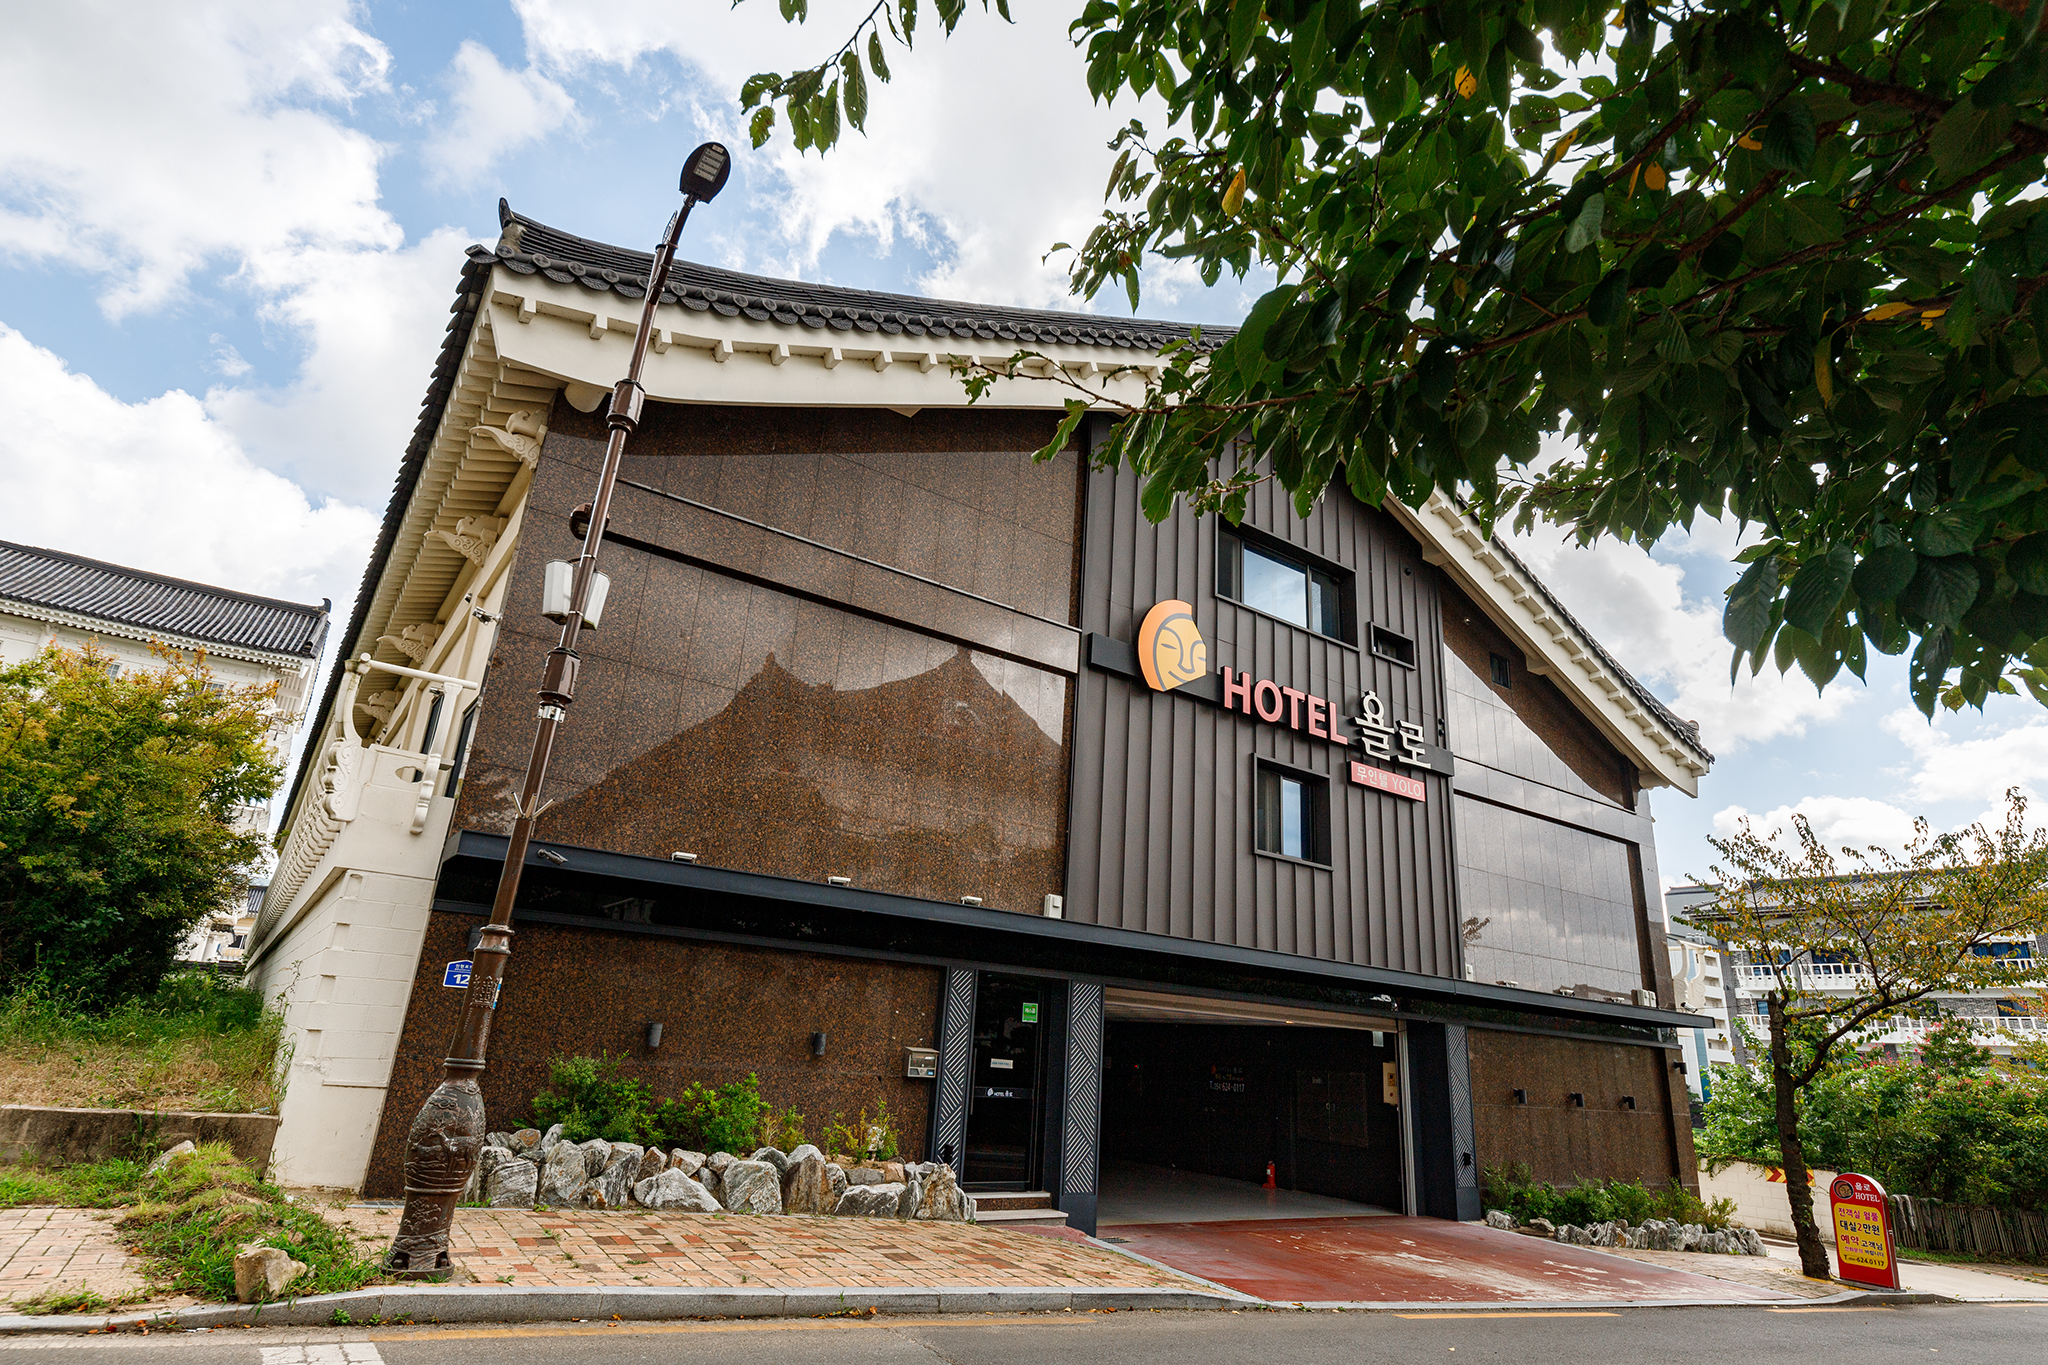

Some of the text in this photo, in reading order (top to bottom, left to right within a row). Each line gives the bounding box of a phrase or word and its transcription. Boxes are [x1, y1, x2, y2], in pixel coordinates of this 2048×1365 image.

[1223, 665, 1431, 769] HOTEL 올로
[1356, 766, 1421, 797] 무인텔 YOLO
[1855, 1182, 1872, 1192] 올로
[1855, 1192, 1881, 1203] HOTEL
[1838, 1207, 1860, 1219] 전객실
[1840, 1234, 1883, 1251] 예약 고객님
